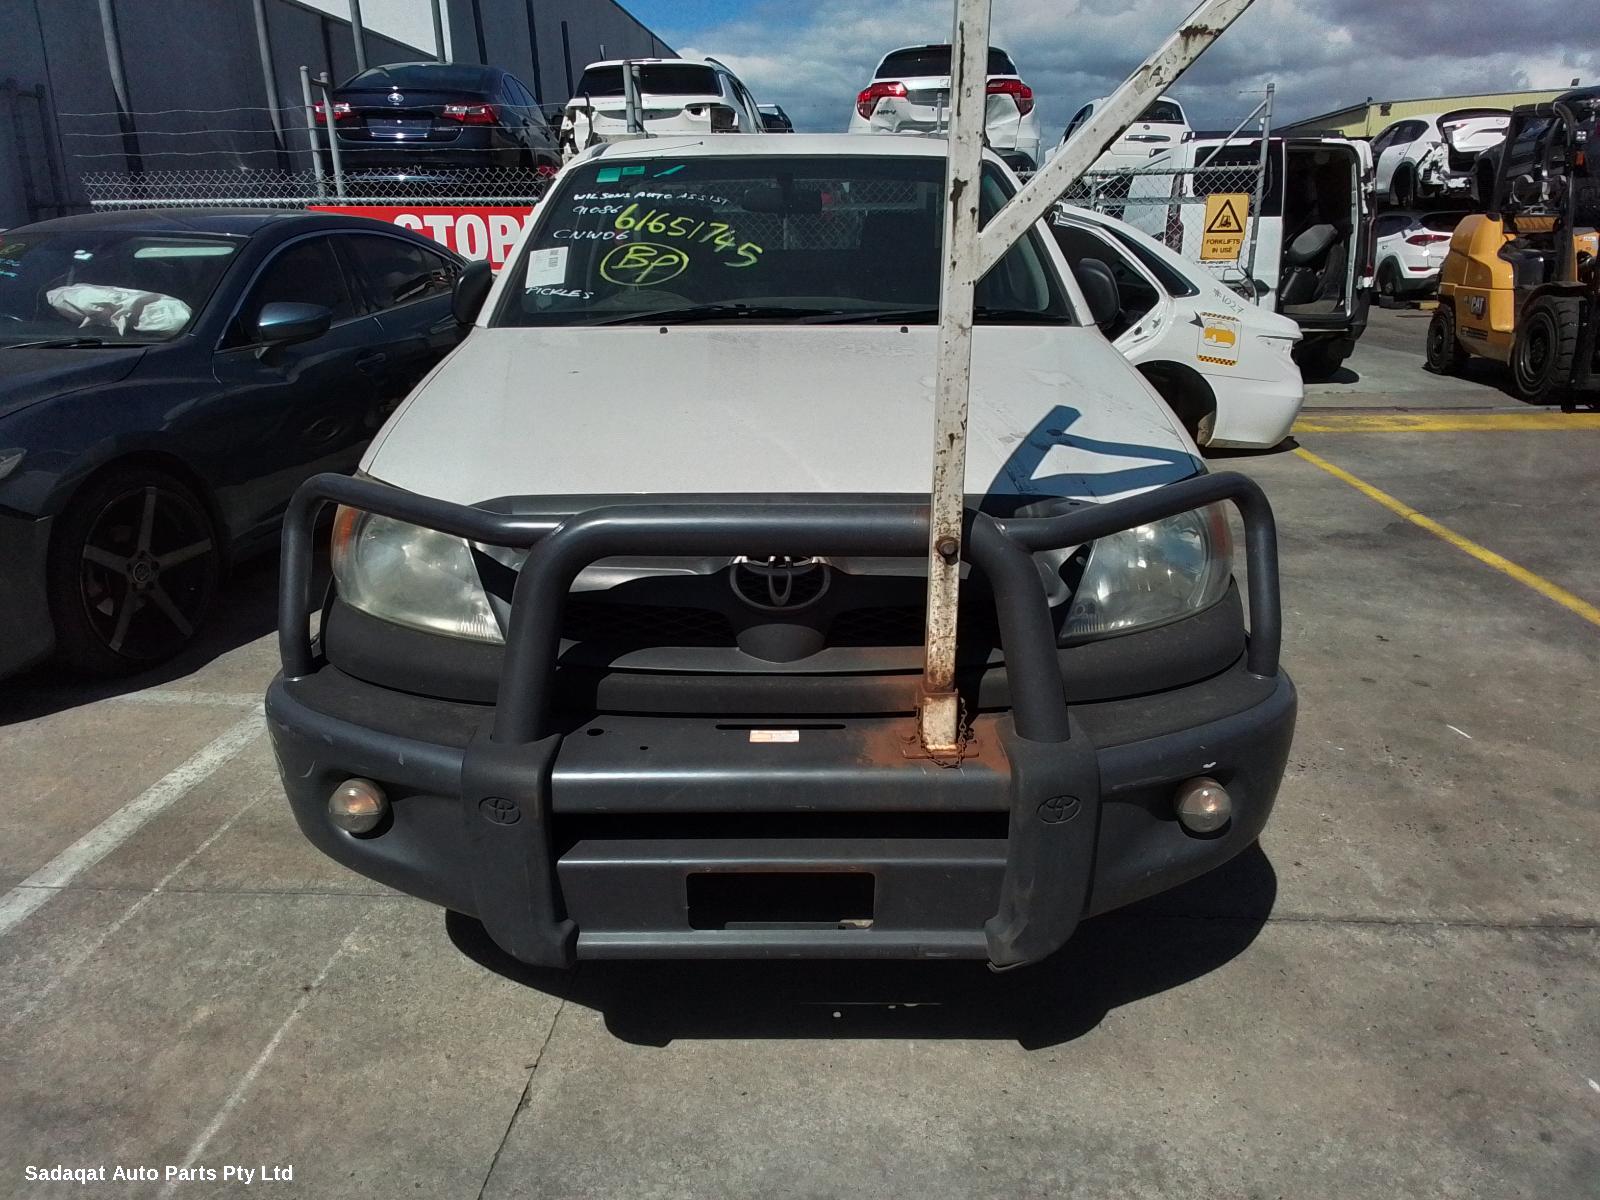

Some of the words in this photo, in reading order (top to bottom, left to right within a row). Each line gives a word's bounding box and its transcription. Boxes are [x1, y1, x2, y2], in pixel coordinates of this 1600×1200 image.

[633, 191, 673, 200] AUTO
[393, 213, 533, 263] TOP
[525, 286, 594, 299] PICKLES
[1470, 295, 1485, 313] CAT
